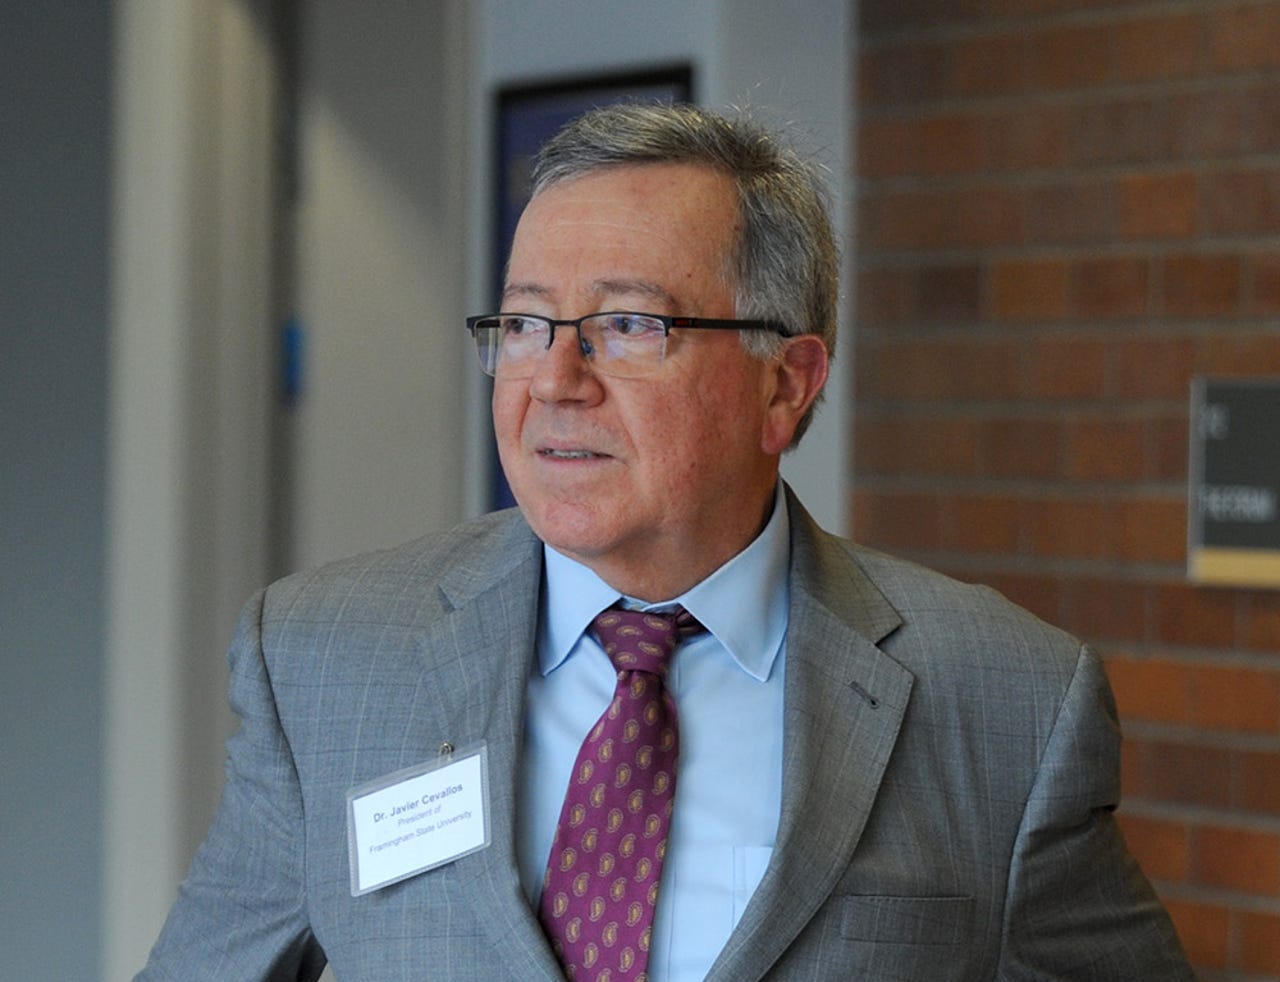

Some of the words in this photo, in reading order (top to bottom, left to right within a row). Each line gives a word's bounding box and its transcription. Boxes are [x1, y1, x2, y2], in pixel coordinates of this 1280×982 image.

[373, 812, 388, 823] Dr.
[390, 798, 420, 817] Javier
[421, 784, 463, 804] Cevallos
[398, 808, 432, 826] President
[434, 804, 441, 814] of
[369, 832, 415, 853] Framingham
[415, 825, 435, 837] State
[437, 811, 472, 828] University
